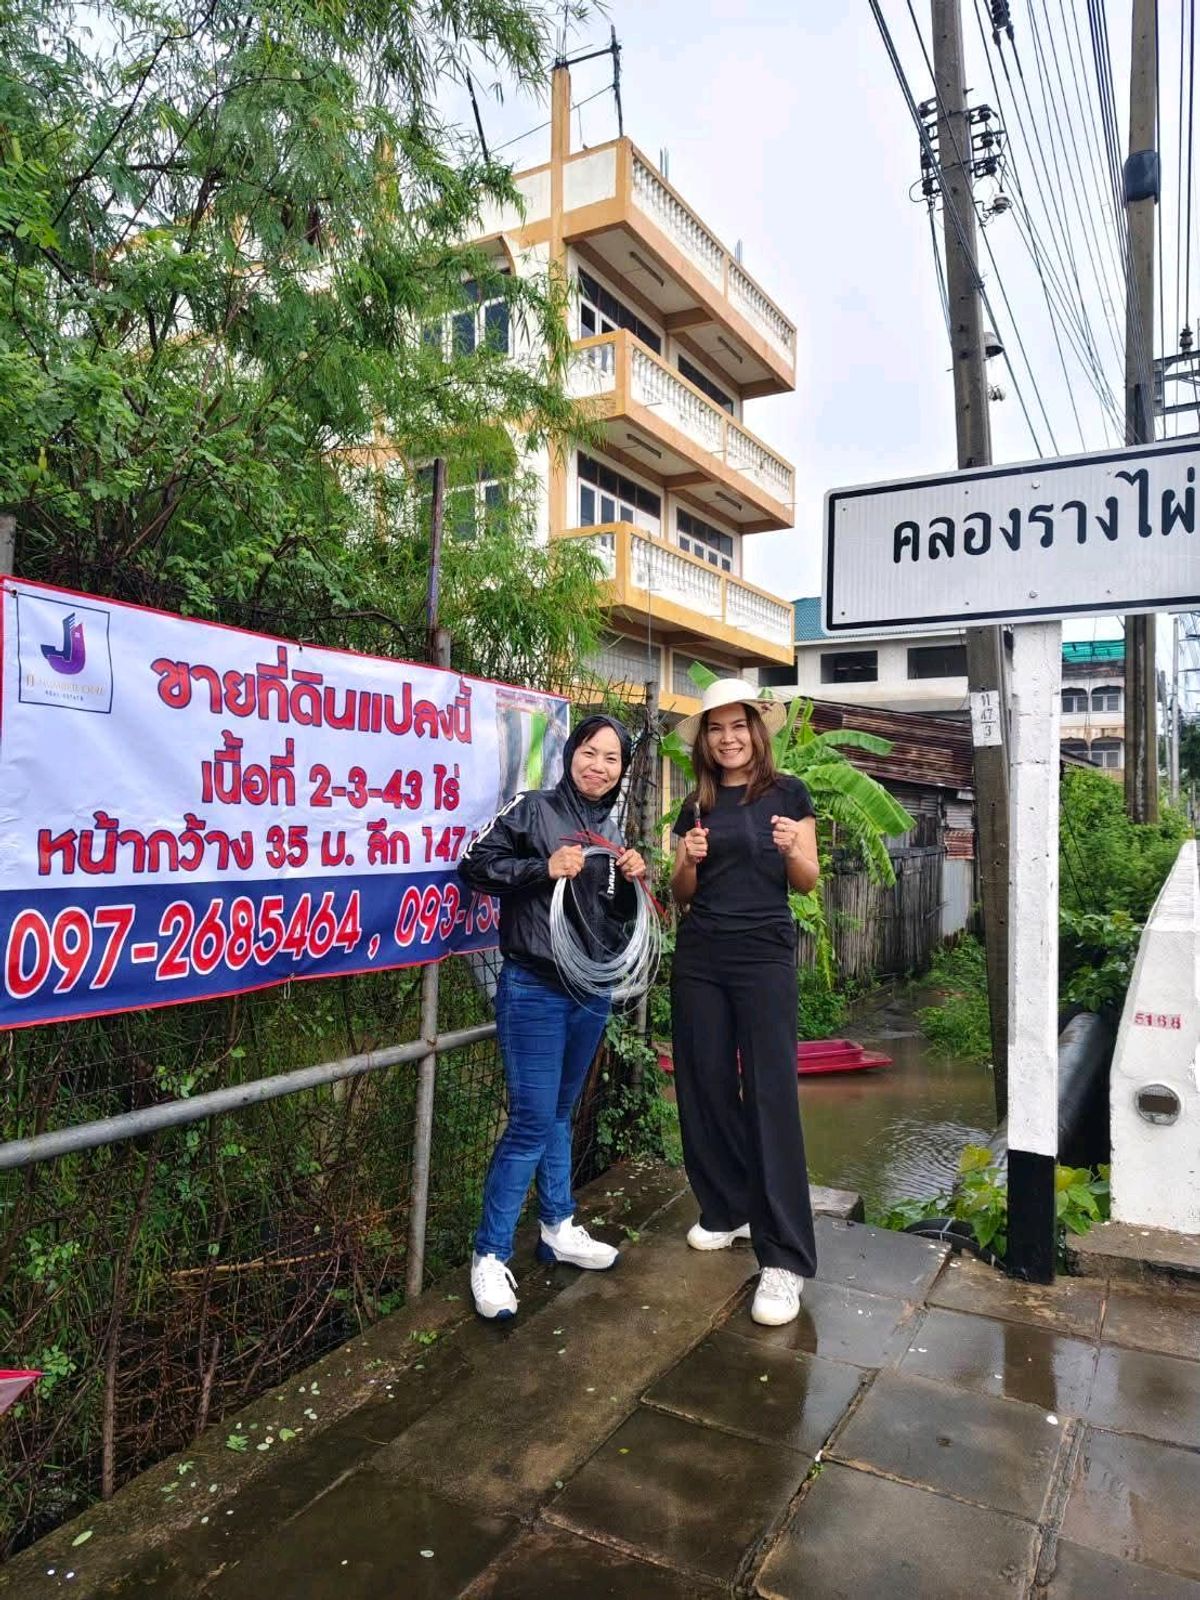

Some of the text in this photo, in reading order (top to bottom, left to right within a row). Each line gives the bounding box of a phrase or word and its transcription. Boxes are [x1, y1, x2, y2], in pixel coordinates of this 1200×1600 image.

[893, 466, 1196, 563] คลองรางไผ่
[150, 645, 473, 744] ขายที่ดินแปลงนี้
[201, 729, 460, 811] เนื้อที่ 2-3-43 ไร่
[38, 810, 466, 876] หน้ากว้าง 35 ม. ลึก 147
